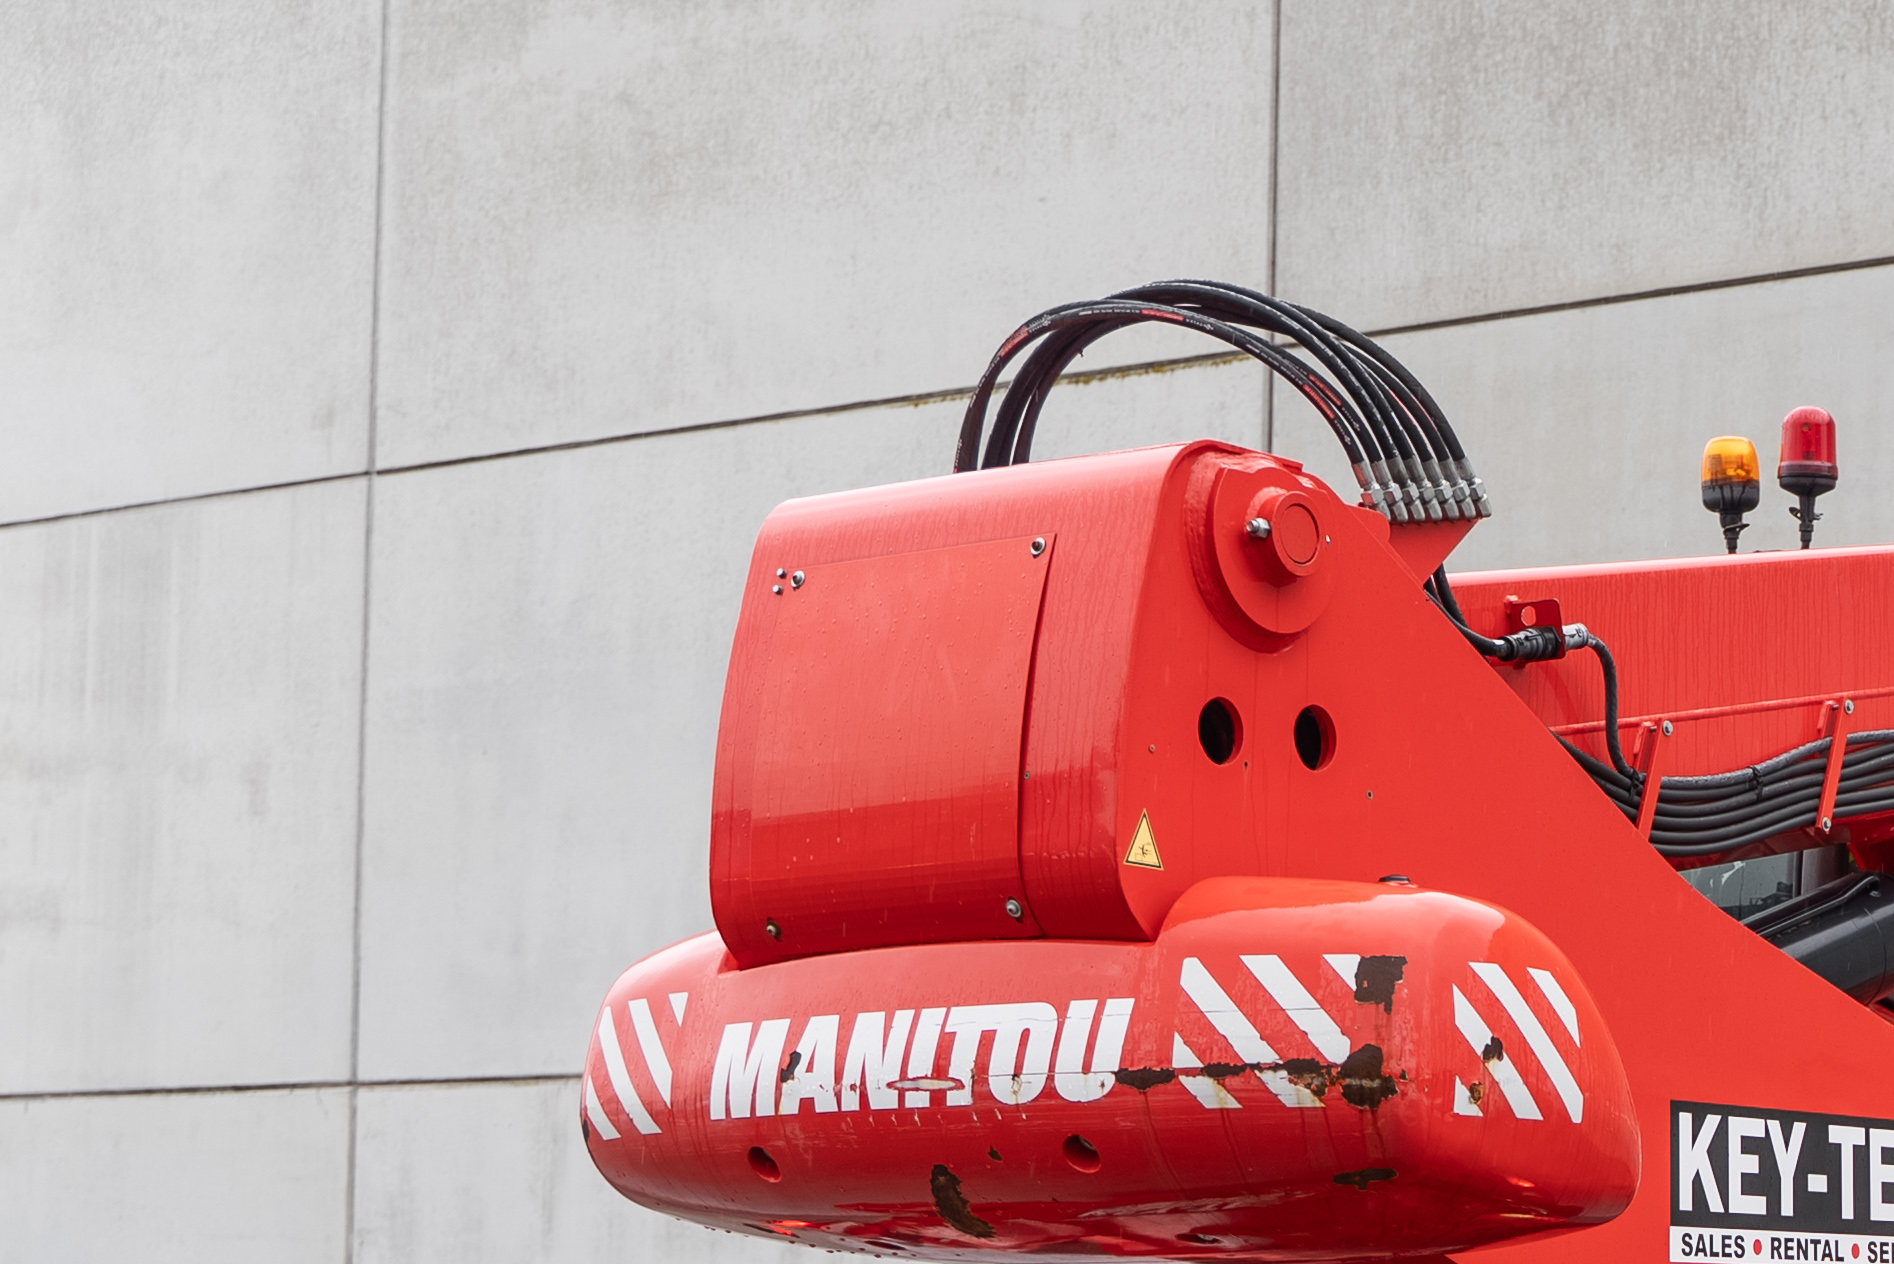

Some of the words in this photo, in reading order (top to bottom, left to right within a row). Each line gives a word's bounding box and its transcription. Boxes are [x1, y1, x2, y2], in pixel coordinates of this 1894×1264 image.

[709, 997, 1136, 1121] MANITOU
[1681, 1232, 1746, 1259] SALES
[1770, 1236, 1845, 1262] RENTAL
